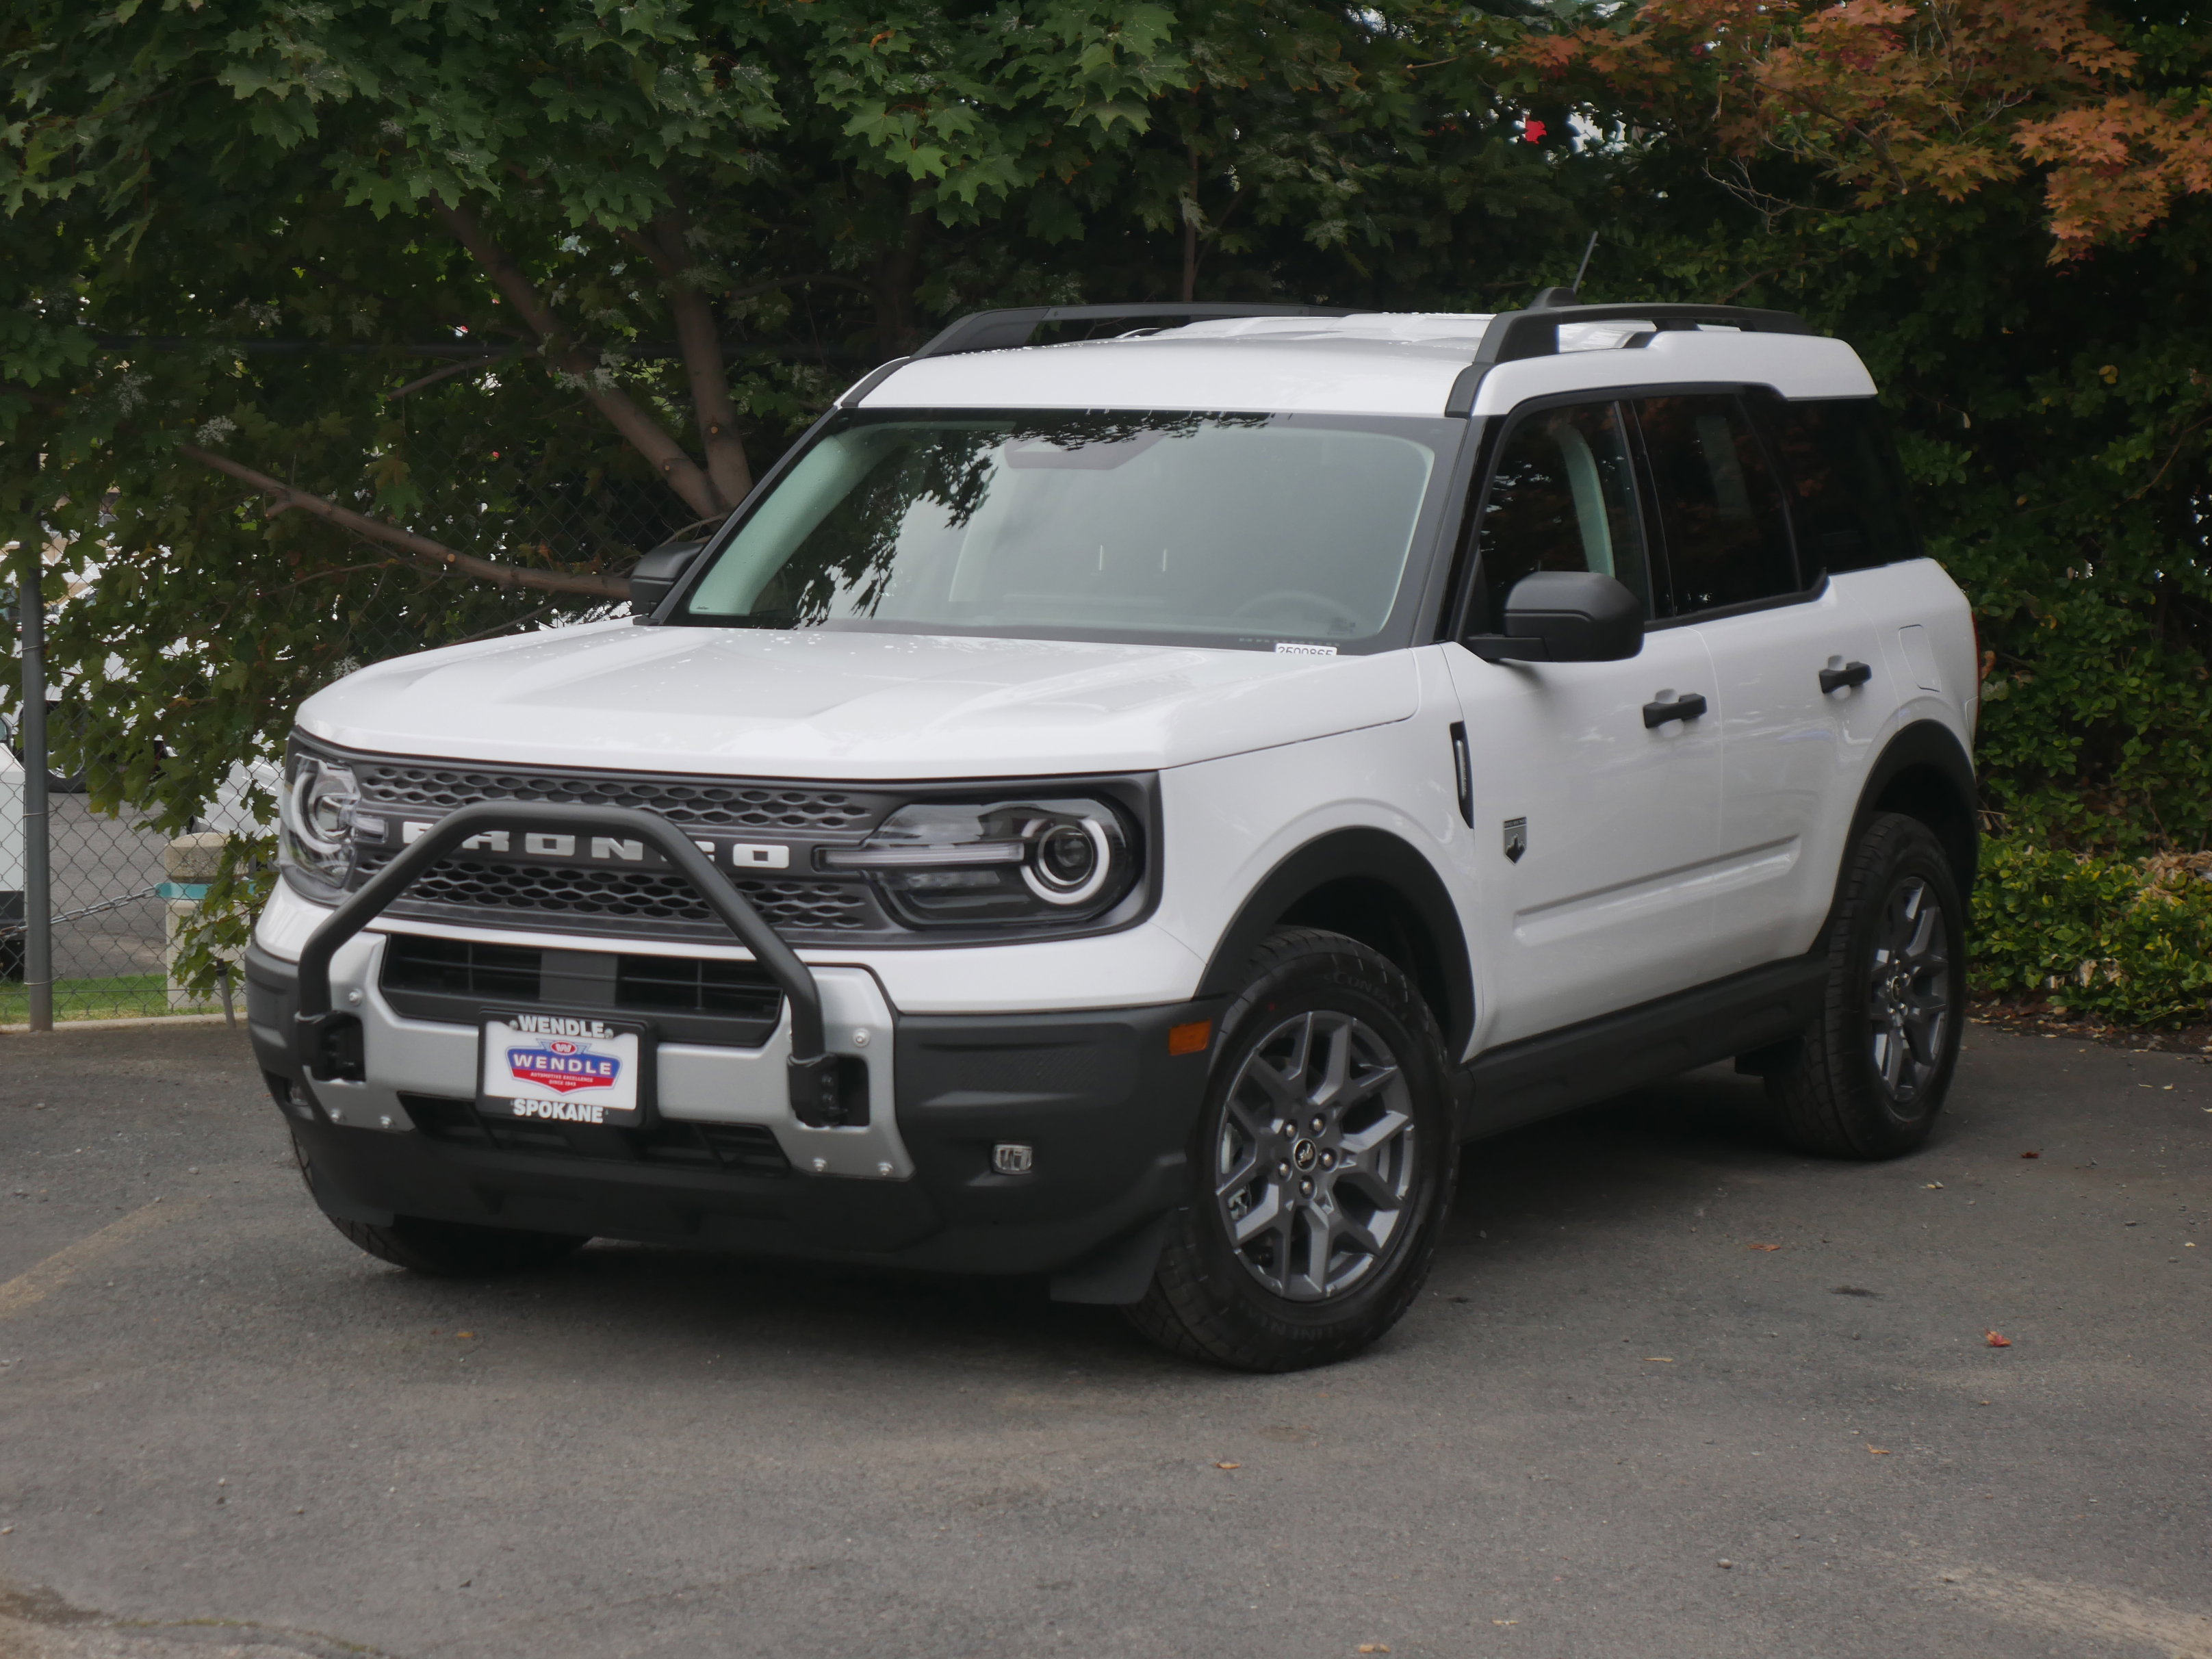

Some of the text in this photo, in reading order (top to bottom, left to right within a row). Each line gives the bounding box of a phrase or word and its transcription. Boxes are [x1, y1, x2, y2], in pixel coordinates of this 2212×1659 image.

[518, 1014, 604, 1039] WENDLE
[513, 1054, 611, 1075] WENDLE
[513, 1099, 603, 1123] SPOKANE
